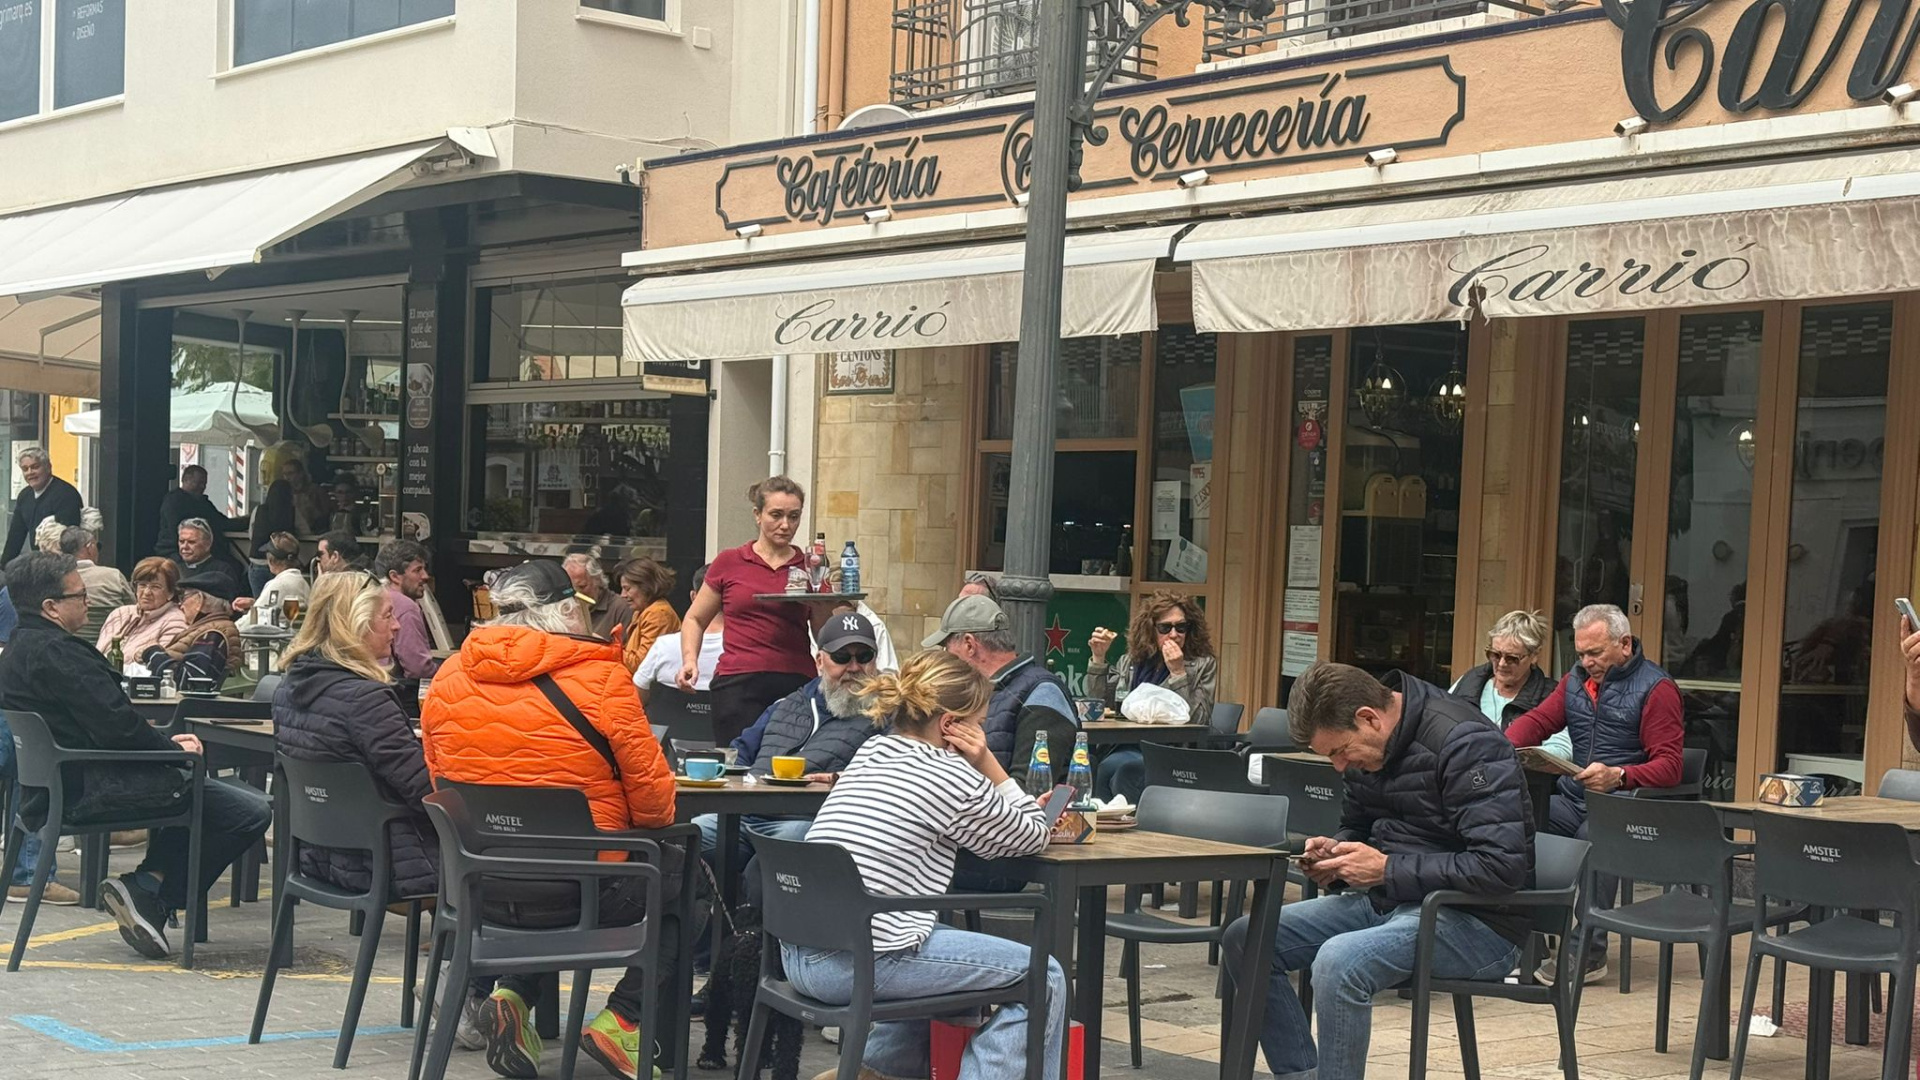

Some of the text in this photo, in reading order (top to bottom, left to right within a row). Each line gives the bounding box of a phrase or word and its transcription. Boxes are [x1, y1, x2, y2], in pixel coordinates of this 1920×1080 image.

[1119, 73, 1371, 178] Cervecería
[777, 137, 941, 225] Cafetería
[1448, 242, 1757, 308] Carrió
[417, 309, 435, 321] mejor
[411, 322, 432, 334] café de
[774, 299, 952, 345] Carrió
[841, 350, 881, 362] CANTONS
[412, 443, 429, 453] ahora
[409, 457, 427, 467] con la
[409, 471, 427, 484] mejor
[686, 703, 711, 711] AMSTEL
[1172, 769, 1198, 780] AMSTEL
[304, 786, 329, 798] AMSTEL
[1304, 785, 1334, 797] AMSTEL
[485, 813, 523, 827] AMSTEL
[1626, 824, 1660, 836] AMSTEL
[1802, 844, 1841, 858] AMSTEL
[776, 872, 802, 888] AMSTEL
